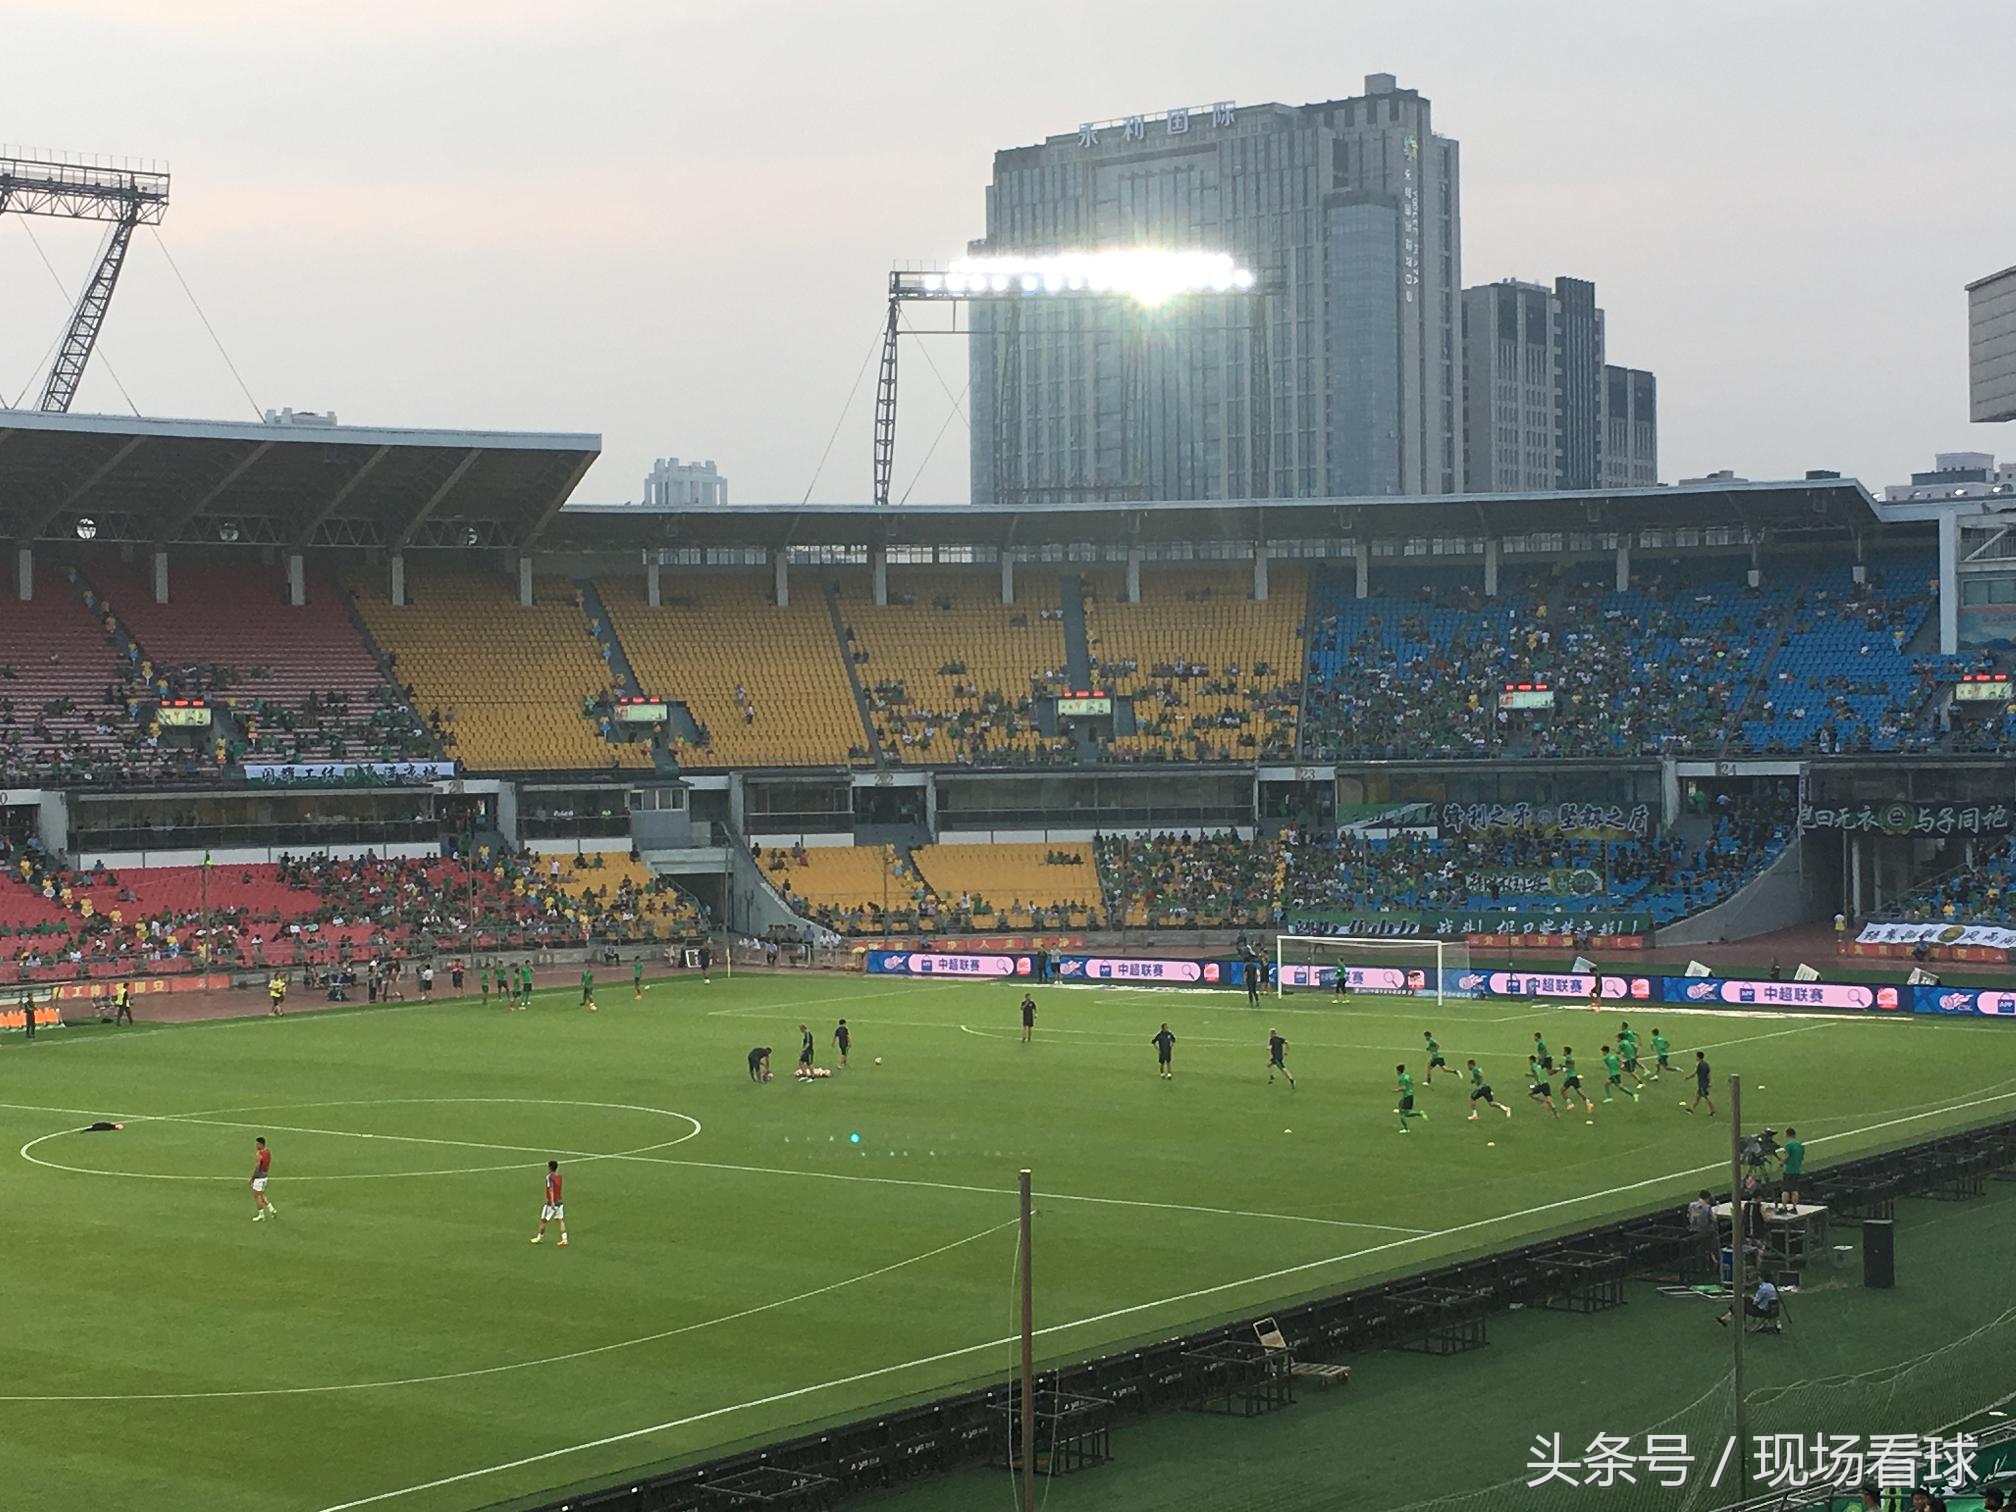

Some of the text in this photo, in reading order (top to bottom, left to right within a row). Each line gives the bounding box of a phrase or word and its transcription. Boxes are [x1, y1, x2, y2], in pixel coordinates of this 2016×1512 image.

[1078, 101, 1237, 148] 永利国际
[1913, 804, 2009, 834] 与子同袍
[938, 958, 981, 973] 中超联赛
[1117, 963, 1164, 978] 中超联赛
[1763, 986, 1824, 1004] 中超联赛
